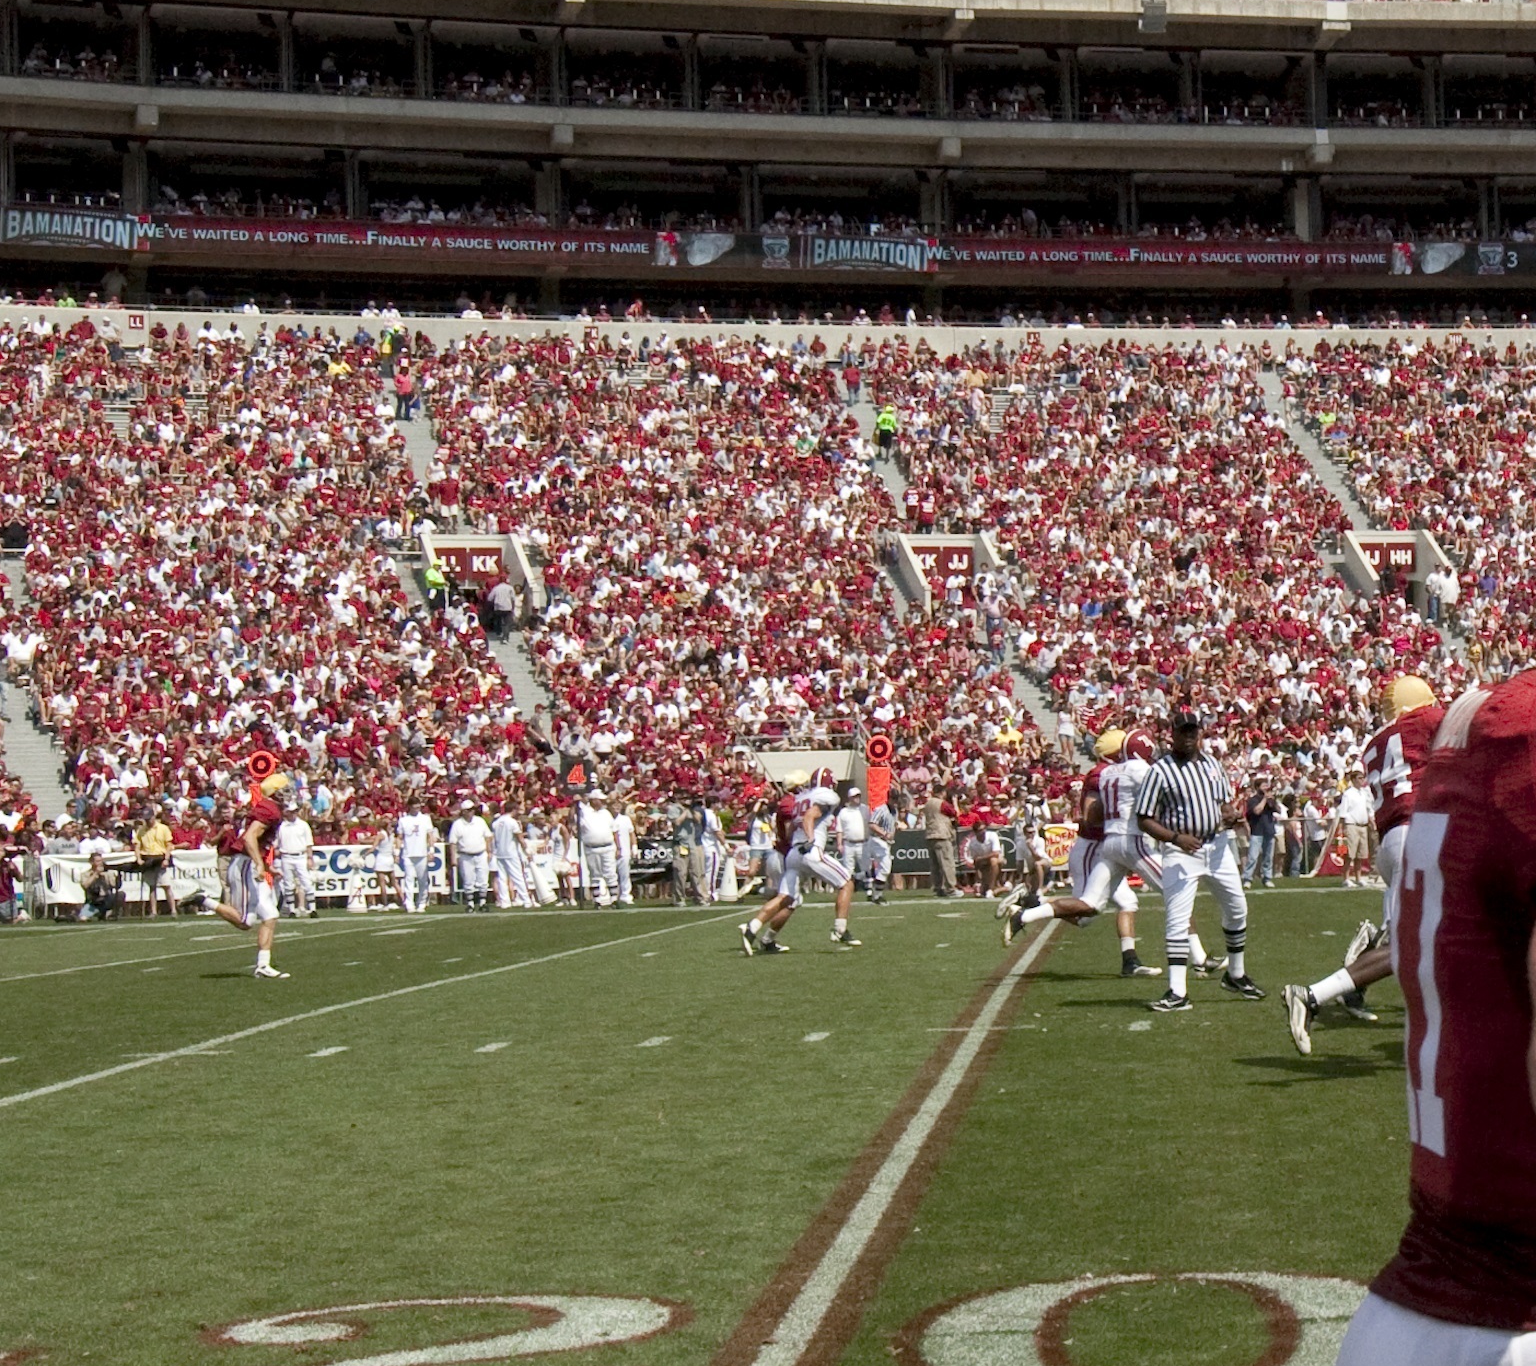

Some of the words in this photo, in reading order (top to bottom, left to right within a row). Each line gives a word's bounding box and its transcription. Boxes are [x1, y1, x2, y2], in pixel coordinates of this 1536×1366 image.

[7, 211, 130, 249] BAMANATION
[192, 229, 250, 241] WAITED
[254, 230, 265, 242] A
[270, 231, 310, 243] LONG
[431, 235, 442, 248] A
[446, 236, 493, 249] SAUCE
[497, 237, 556, 251] WORTHY
[560, 239, 579, 252] OF
[584, 240, 606, 253] ITS
[610, 241, 650, 254] NAME
[814, 238, 921, 272] BAMANATION
[976, 250, 1025, 261] WAITED
[1029, 251, 1039, 261] A
[1042, 251, 1079, 262] LONG
[1188, 252, 1198, 263] A
[1200, 252, 1243, 263] SAUCE
[1246, 253, 1300, 264] WORTHY
[1305, 253, 1321, 264] OF
[1326, 253, 1346, 264] ITS
[1350, 253, 1387, 264] NAME
[1507, 251, 1518, 268] 3
[948, 553, 969, 570] JJ
[1389, 549, 1412, 565] HH
[566, 763, 587, 784] 4
[1103, 777, 1120, 820] 11
